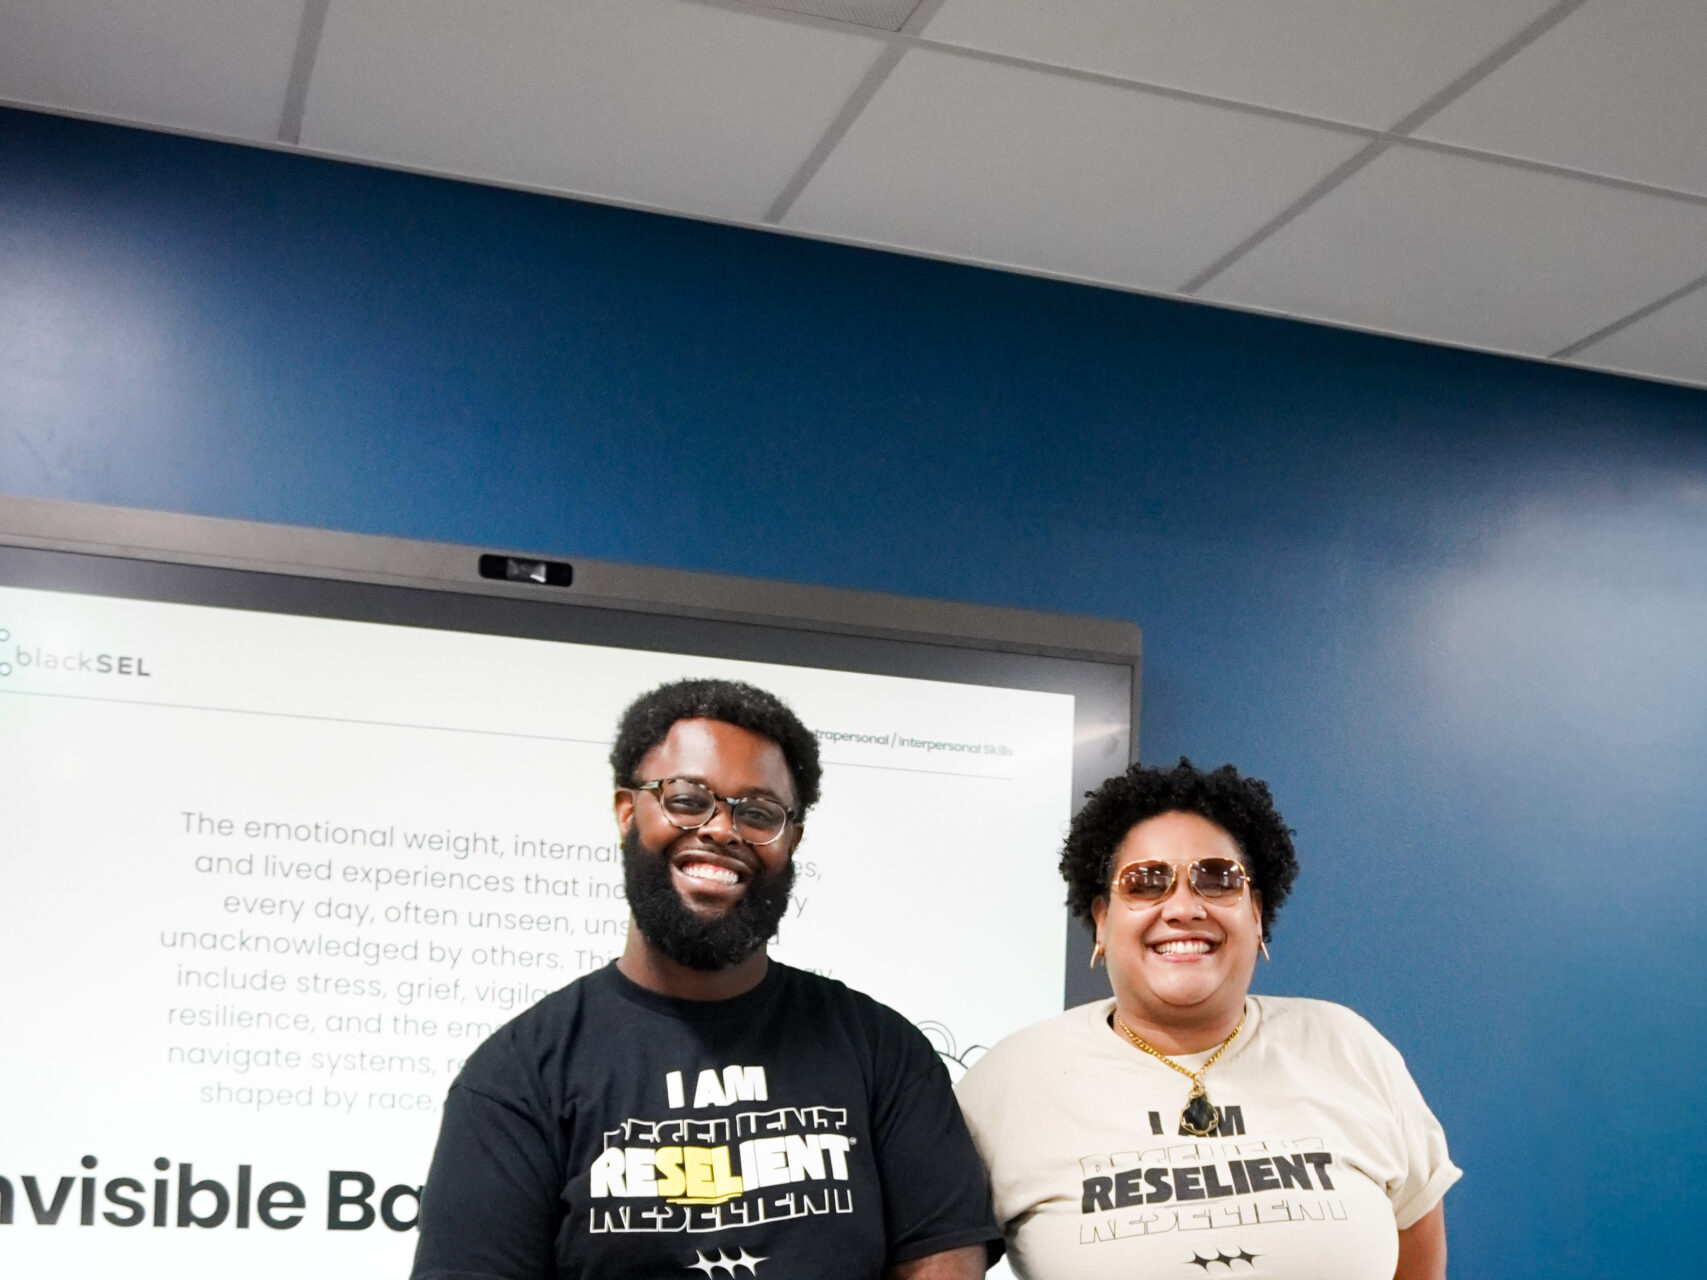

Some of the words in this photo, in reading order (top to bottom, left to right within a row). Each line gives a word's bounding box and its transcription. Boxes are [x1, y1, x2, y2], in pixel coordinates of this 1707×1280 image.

[16, 645, 151, 677] blackSEL
[814, 729, 889, 744] trapersonal
[899, 736, 981, 753] Interpersonal
[181, 811, 235, 837] The
[244, 820, 395, 848] emotional
[404, 829, 505, 861] weight,
[195, 853, 254, 876] and
[264, 854, 333, 881] lived
[342, 864, 515, 894] experiences
[524, 872, 580, 898] that
[223, 895, 305, 924] every
[314, 897, 375, 928] day,
[384, 901, 458, 927] often
[467, 911, 576, 937] unseen,
[160, 929, 418, 966] unacknowledged
[428, 941, 463, 970] by
[471, 946, 565, 970] others.
[177, 964, 287, 992] include
[297, 973, 387, 1000] stress,
[396, 977, 465, 1006] grief,
[168, 1004, 315, 1034] resilience,
[325, 1012, 382, 1034] and
[392, 1014, 438, 1037] the
[168, 1043, 301, 1074] navigate
[311, 1051, 437, 1077] systems,
[201, 1081, 313, 1112] shaped
[324, 1085, 358, 1114] by
[368, 1092, 438, 1113] race,
[665, 1071, 685, 1109] I
[693, 1064, 768, 1109] AM
[1148, 1110, 1164, 1136] I
[590, 1133, 850, 1199] RESELIENT
[1082, 1152, 1335, 1214] RESELIENT
[0, 1154, 307, 1231] visible
